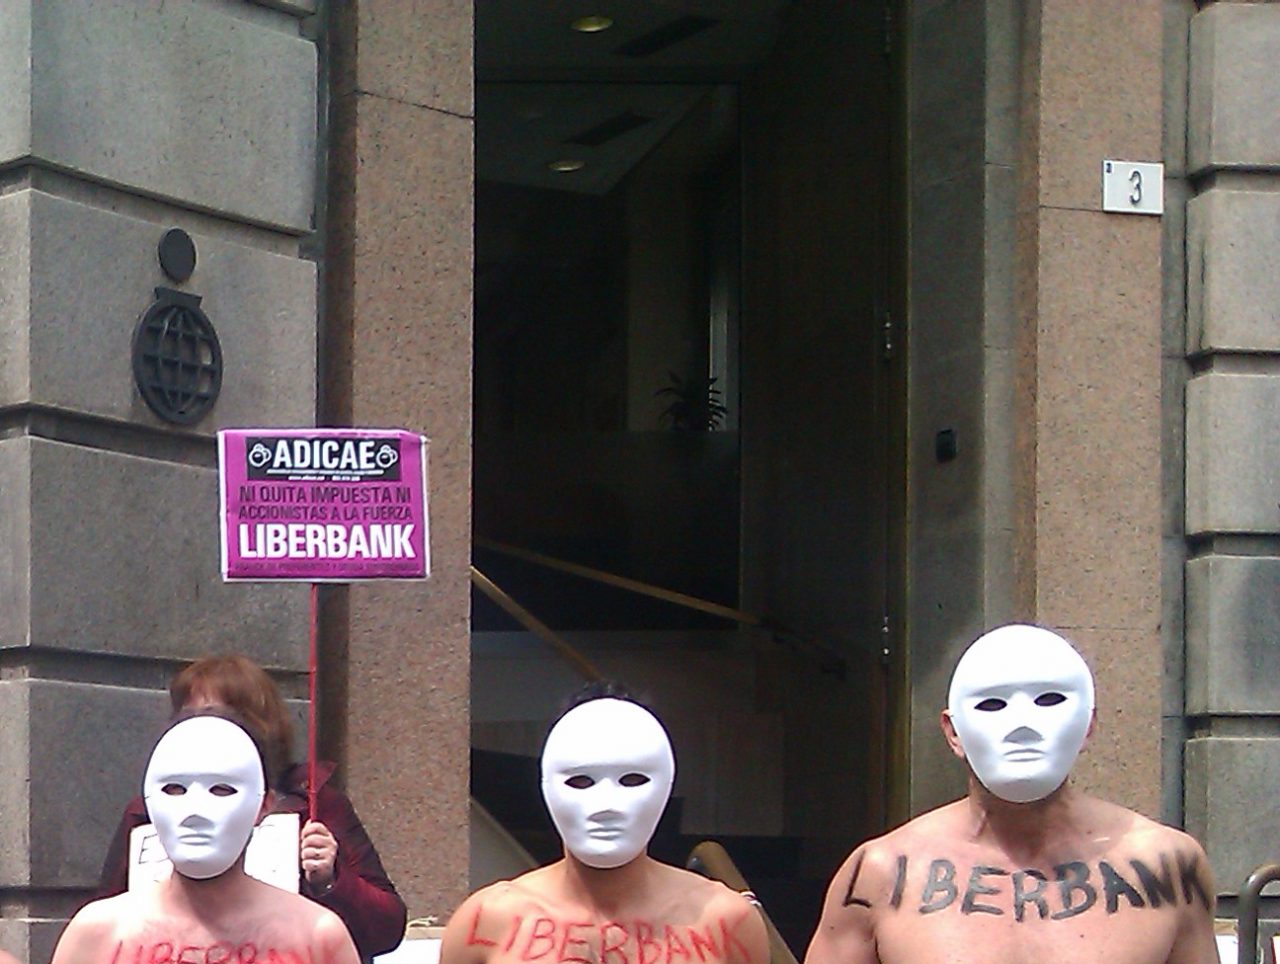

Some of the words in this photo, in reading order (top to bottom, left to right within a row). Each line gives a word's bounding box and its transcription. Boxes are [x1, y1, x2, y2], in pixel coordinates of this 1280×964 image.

[1129, 170, 1142, 205] 3
[272, 440, 377, 470] ADICAE
[239, 486, 255, 503] NI
[260, 486, 310, 503] QUITA
[312, 486, 391, 504] IMPUESTA
[396, 487, 411, 504] NI
[238, 504, 328, 520] ACCIONISTAS
[331, 505, 341, 521] A
[343, 505, 360, 521] LA
[363, 505, 413, 521] FUERZA
[239, 523, 416, 559] LIBERBANK
[843, 849, 1216, 923] LIBERBANK
